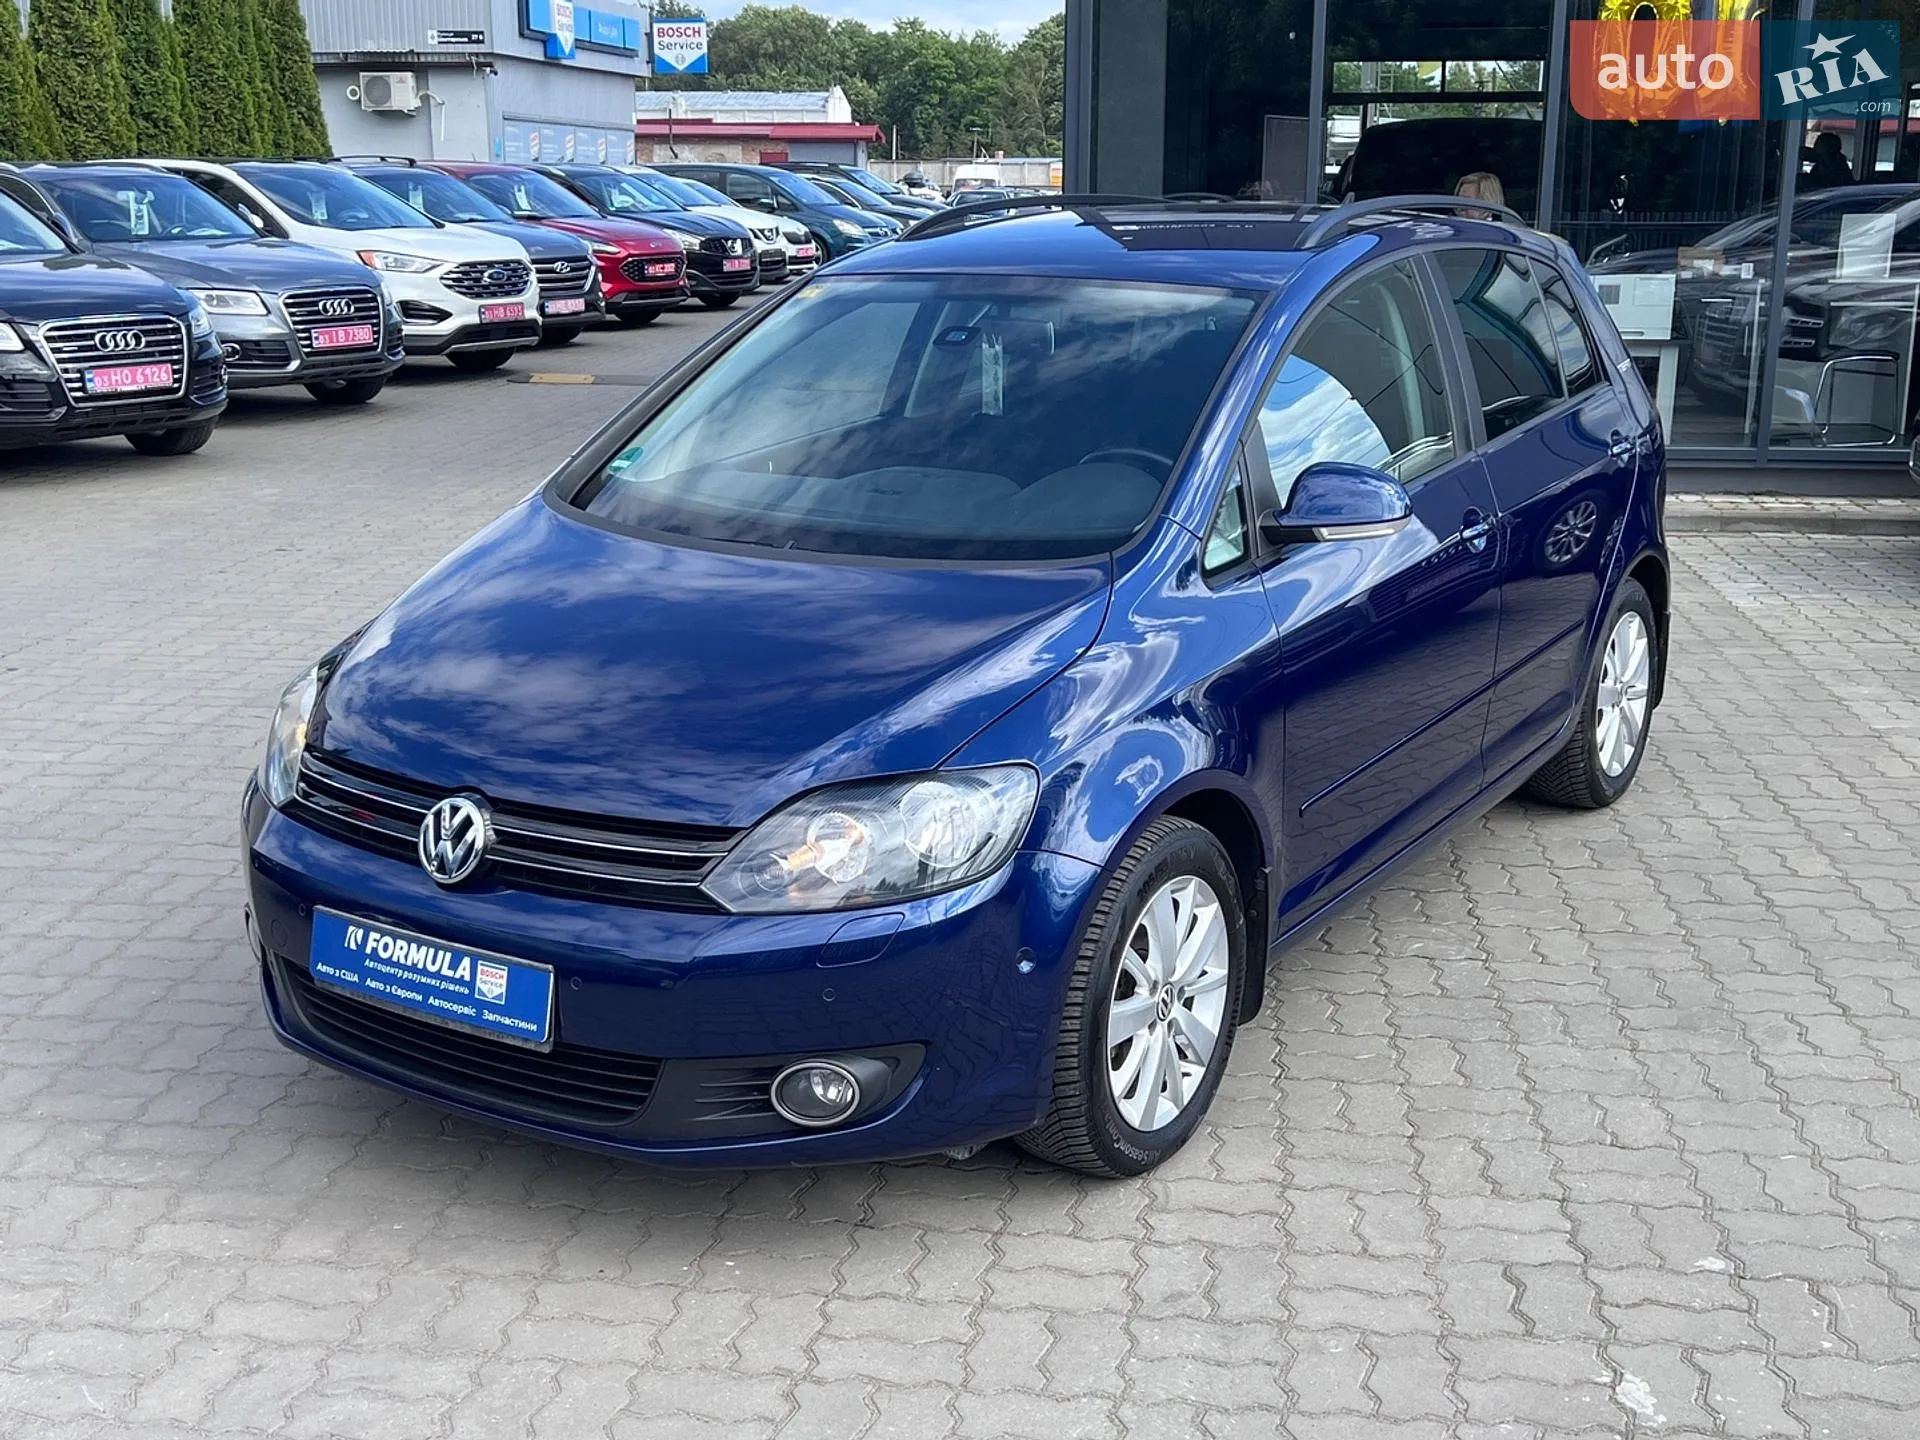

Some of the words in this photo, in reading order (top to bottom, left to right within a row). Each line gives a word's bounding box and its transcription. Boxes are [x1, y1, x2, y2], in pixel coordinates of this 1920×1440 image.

[556, 3, 572, 18] BOSCH
[657, 26, 702, 38] BOSCH
[658, 40, 703, 51] Service
[136, 366, 168, 383] 6126
[365, 931, 471, 981] FORMULA
[316, 962, 335, 976] Авто
[340, 969, 360, 984] США
[364, 958, 403, 978] Автоцентр
[402, 971, 440, 988] розумних
[440, 979, 470, 996] рішень
[480, 967, 505, 981] BOSCH
[365, 977, 385, 992] Авто
[391, 985, 423, 1004] Європи
[479, 978, 504, 990] Service
[428, 995, 478, 1017] Автосервіс
[482, 1009, 538, 1033] Запчастини
